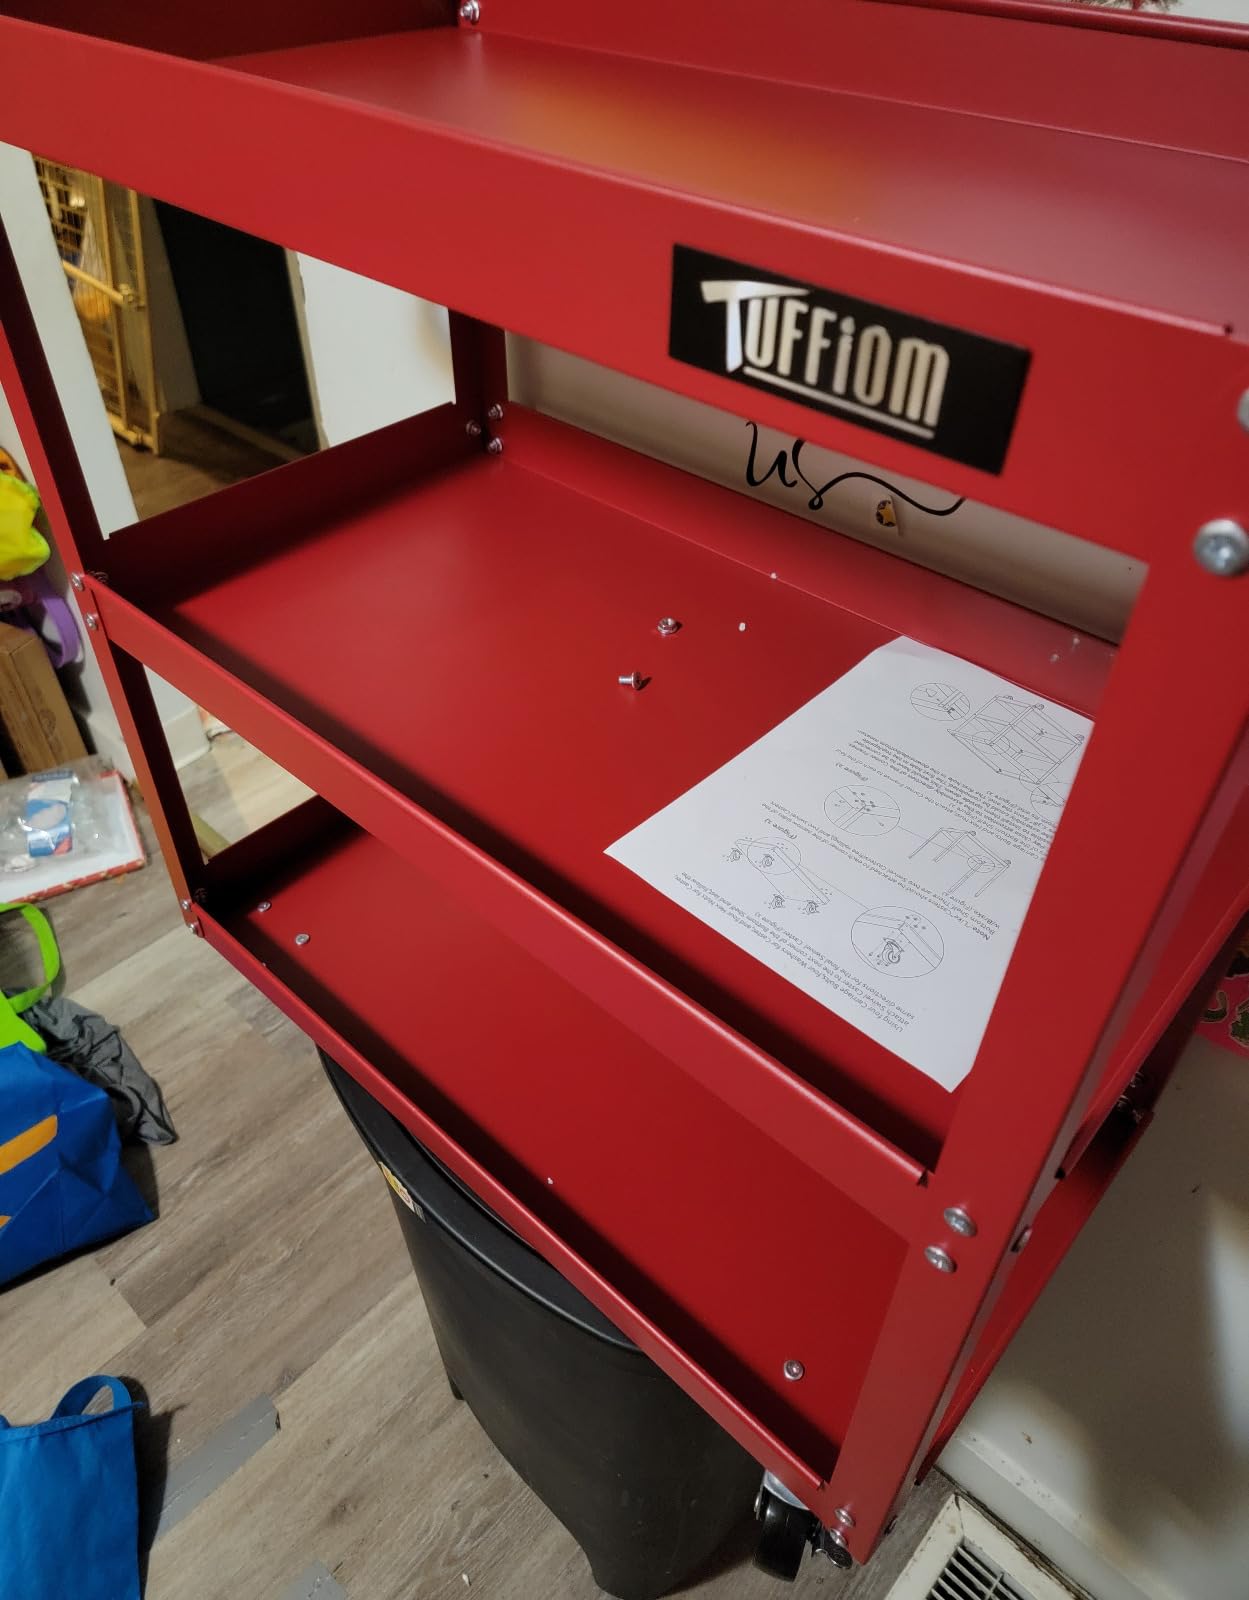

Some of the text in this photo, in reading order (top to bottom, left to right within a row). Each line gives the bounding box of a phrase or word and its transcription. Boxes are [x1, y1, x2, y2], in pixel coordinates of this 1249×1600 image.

[862, 763, 875, 772] each
[792, 820, 811, 834] narrow
[994, 827, 1018, 842] Bottom
[847, 853, 862, 865] each
[1012, 842, 1039, 860] Carriage
[700, 893, 715, 906] Nuts
[905, 885, 927, 901] should
[729, 904, 746, 917] Shelf
[745, 914, 769, 933] Bottom
[969, 915, 995, 934] Bottom
[803, 943, 825, 960] Swivel
[806, 955, 822, 968] next
[824, 957, 839, 970] final
[841, 978, 863, 995] Caster
[861, 982, 895, 1007] directions
[839, 985, 868, 1008] Carriage
[862, 993, 886, 1011] Swivel
[886, 1008, 909, 1026] attach
[895, 1004, 914, 1019] same
[882, 1014, 904, 1032] Using
